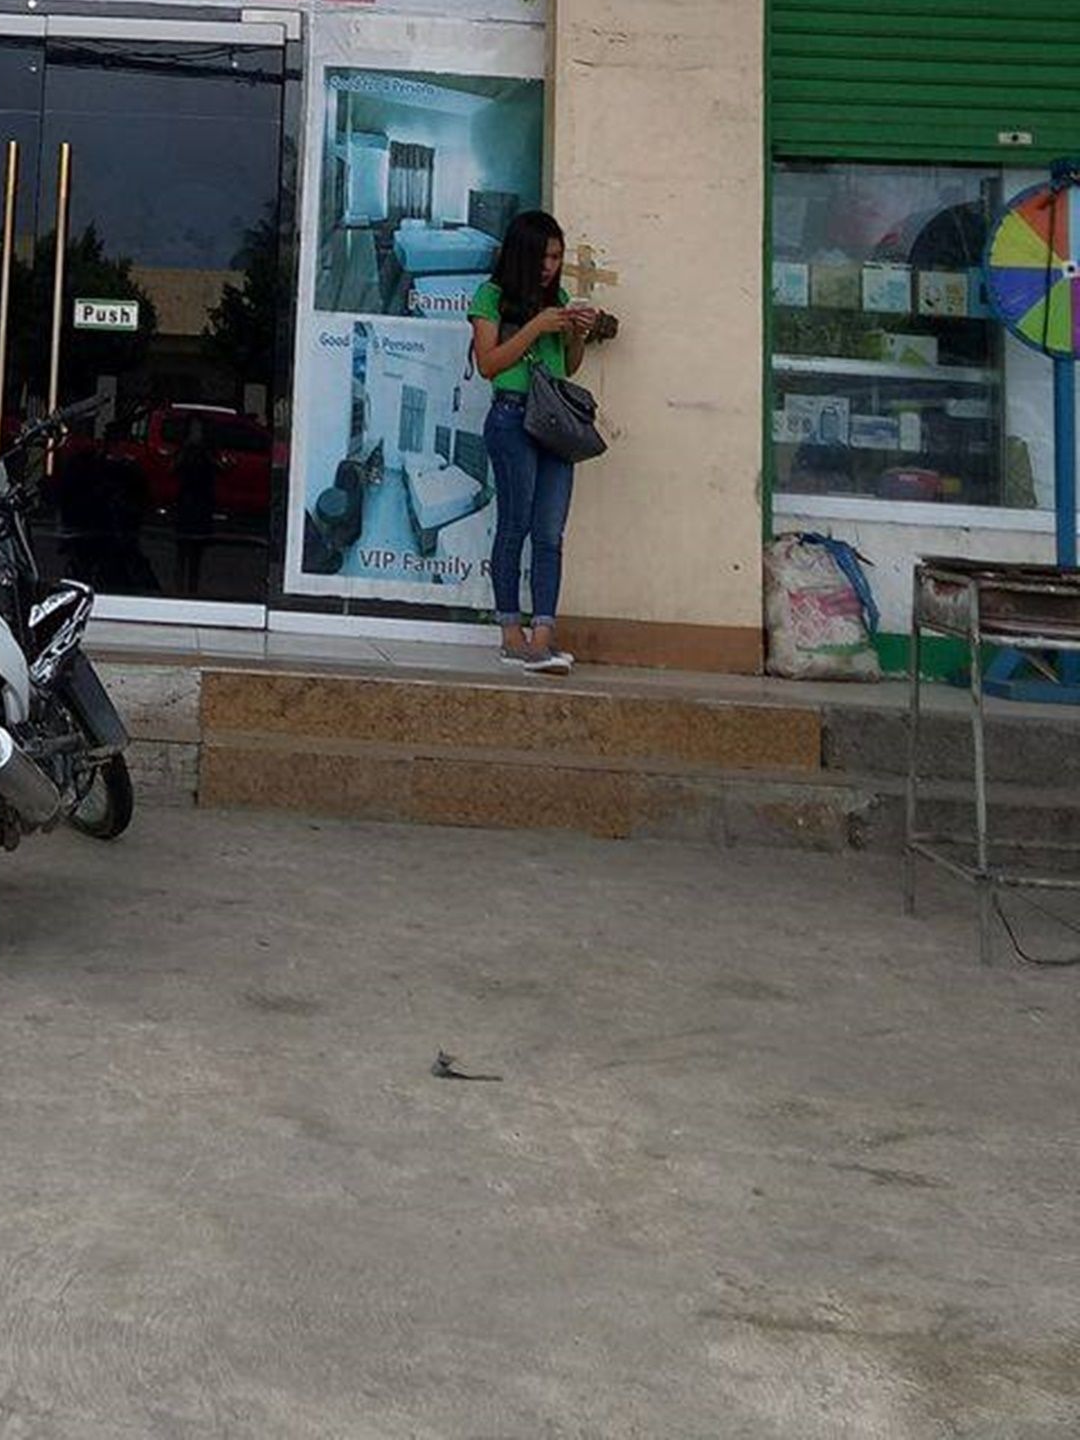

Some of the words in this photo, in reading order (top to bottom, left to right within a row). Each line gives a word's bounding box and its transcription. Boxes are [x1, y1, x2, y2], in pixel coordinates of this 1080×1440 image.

[81, 306, 131, 324] Push
[359, 550, 395, 569] VIP
[402, 554, 473, 579] Family
